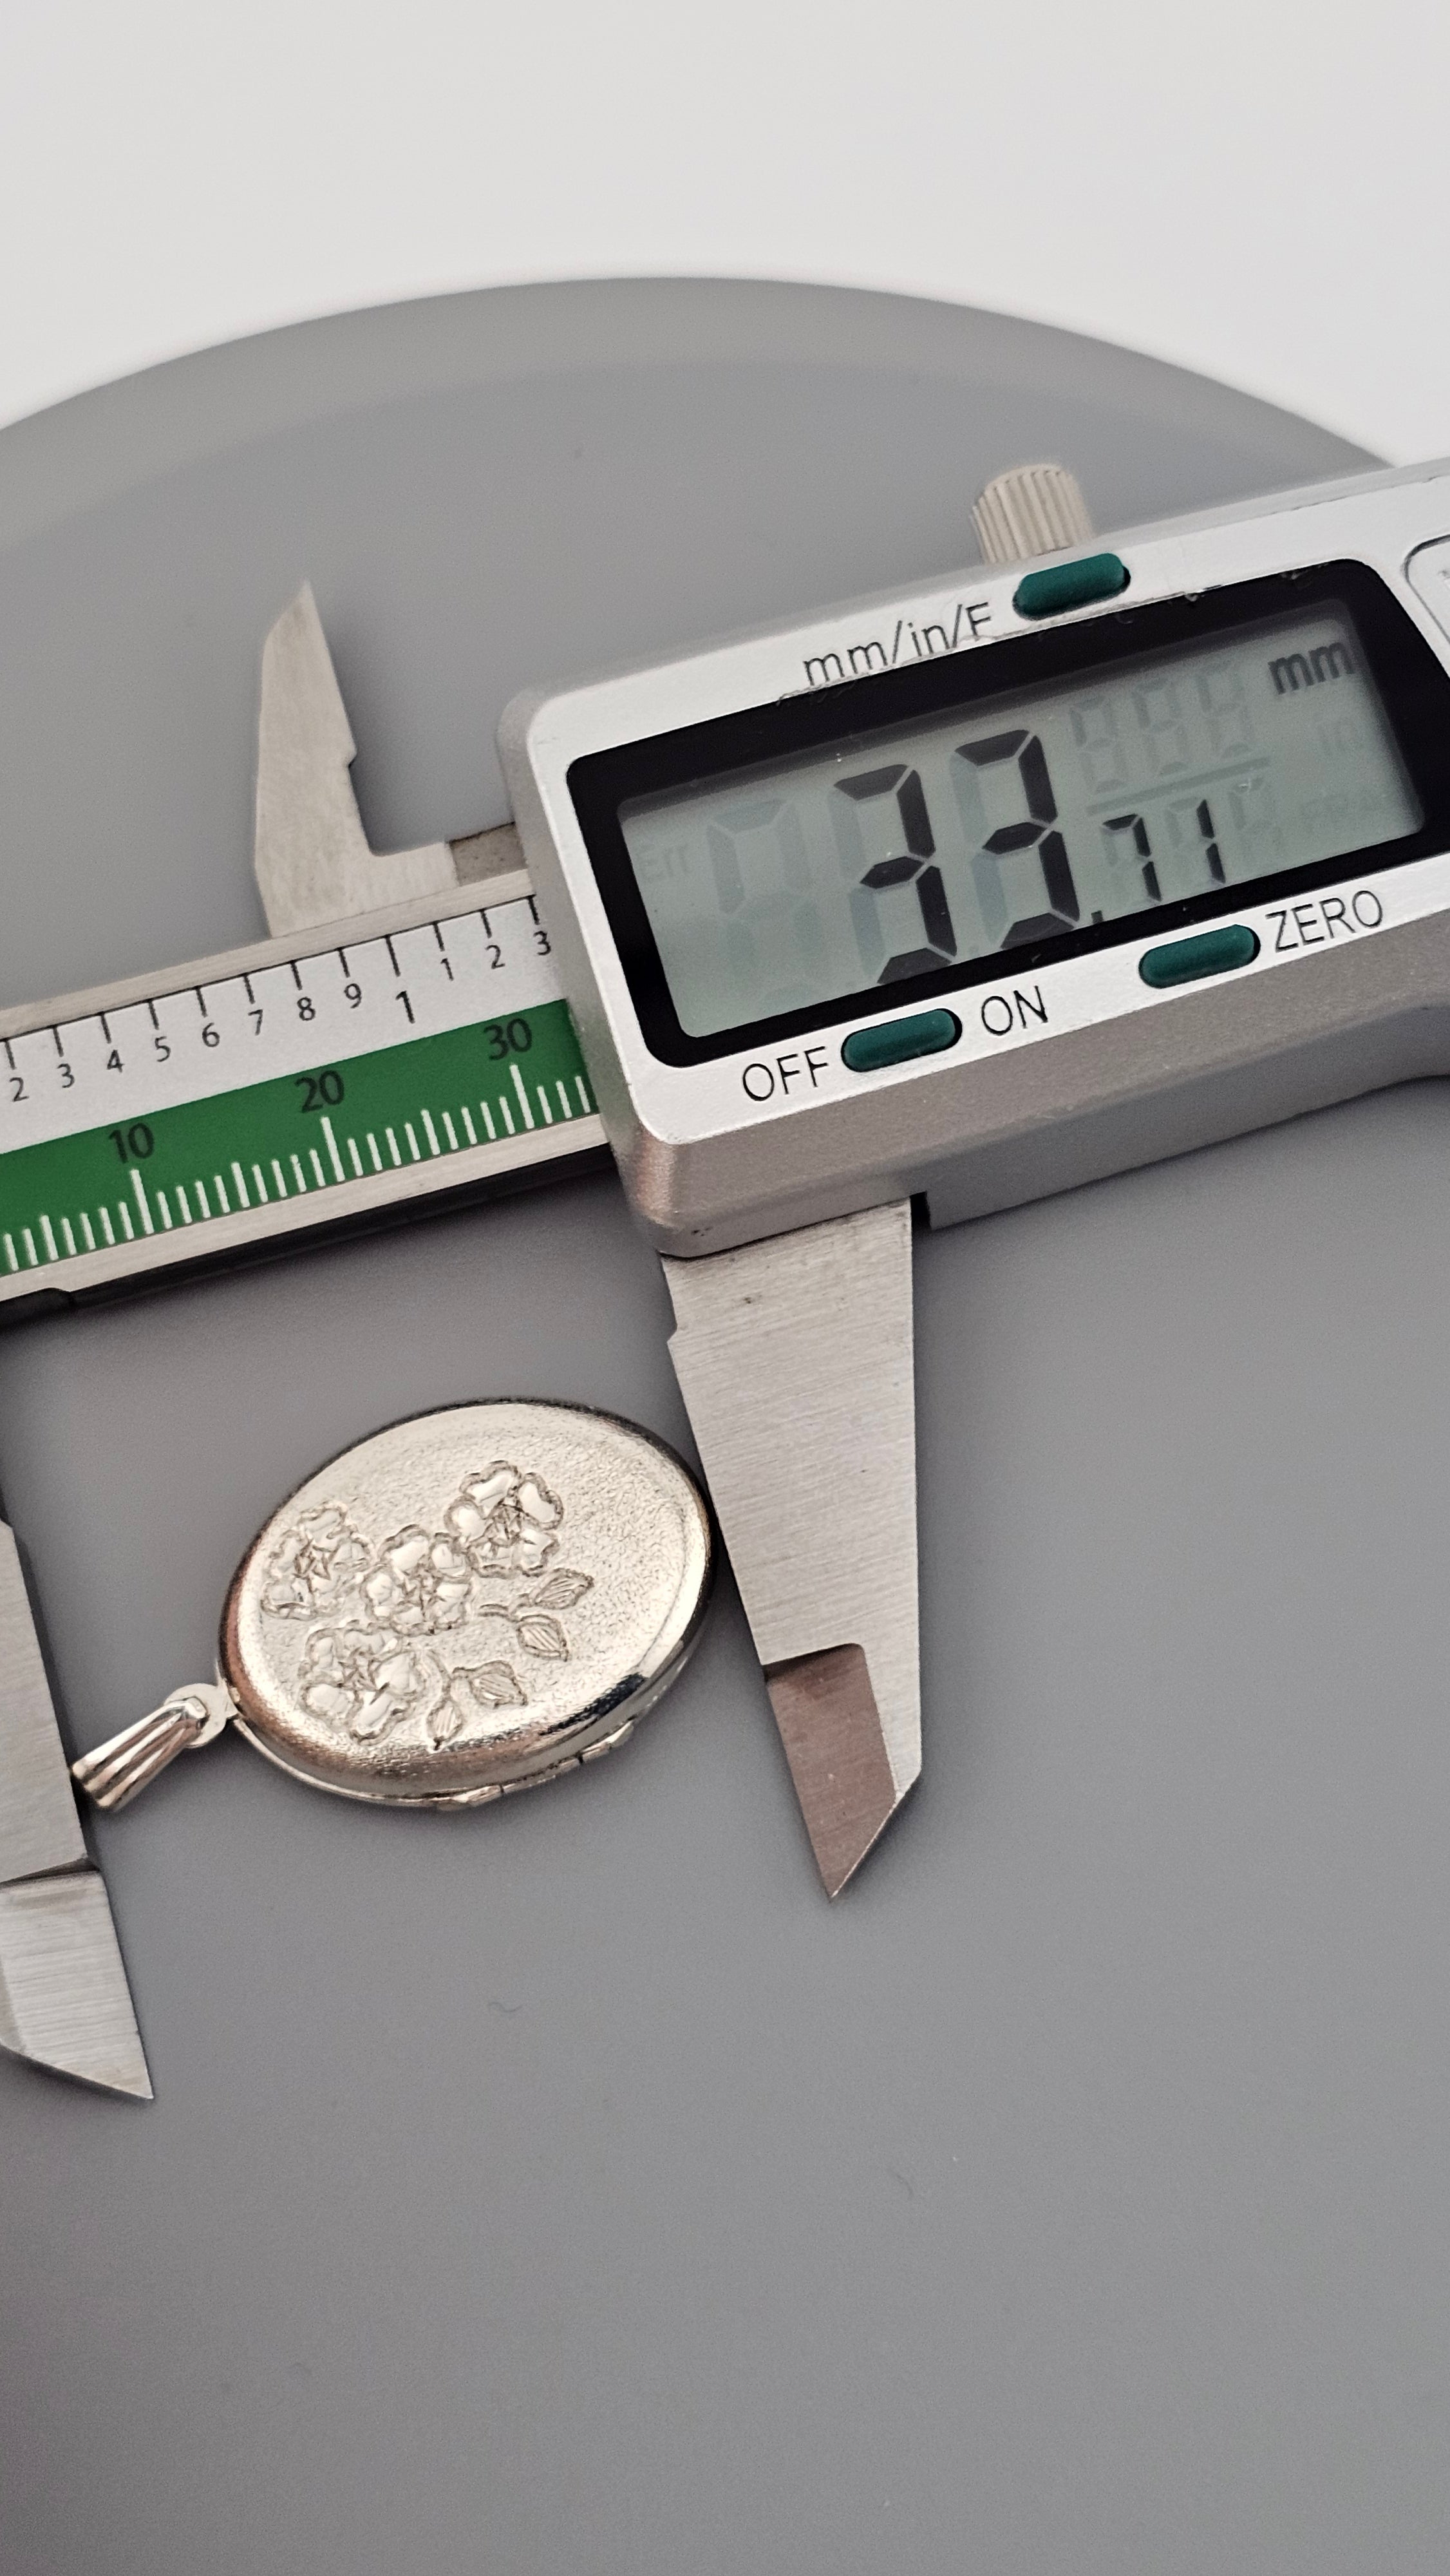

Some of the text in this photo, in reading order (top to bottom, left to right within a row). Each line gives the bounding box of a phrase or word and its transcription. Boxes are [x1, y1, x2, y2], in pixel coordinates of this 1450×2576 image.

[1268, 642, 1356, 695] mm
[1265, 890, 1384, 953] ZERO
[10, 931, 552, 1103] 2 3 4 5 6 7 8 9 1 1 2 3
[981, 985, 1048, 1036] ON
[109, 1018, 532, 1163] 10 20 30
[742, 1046, 829, 1101] OFF
